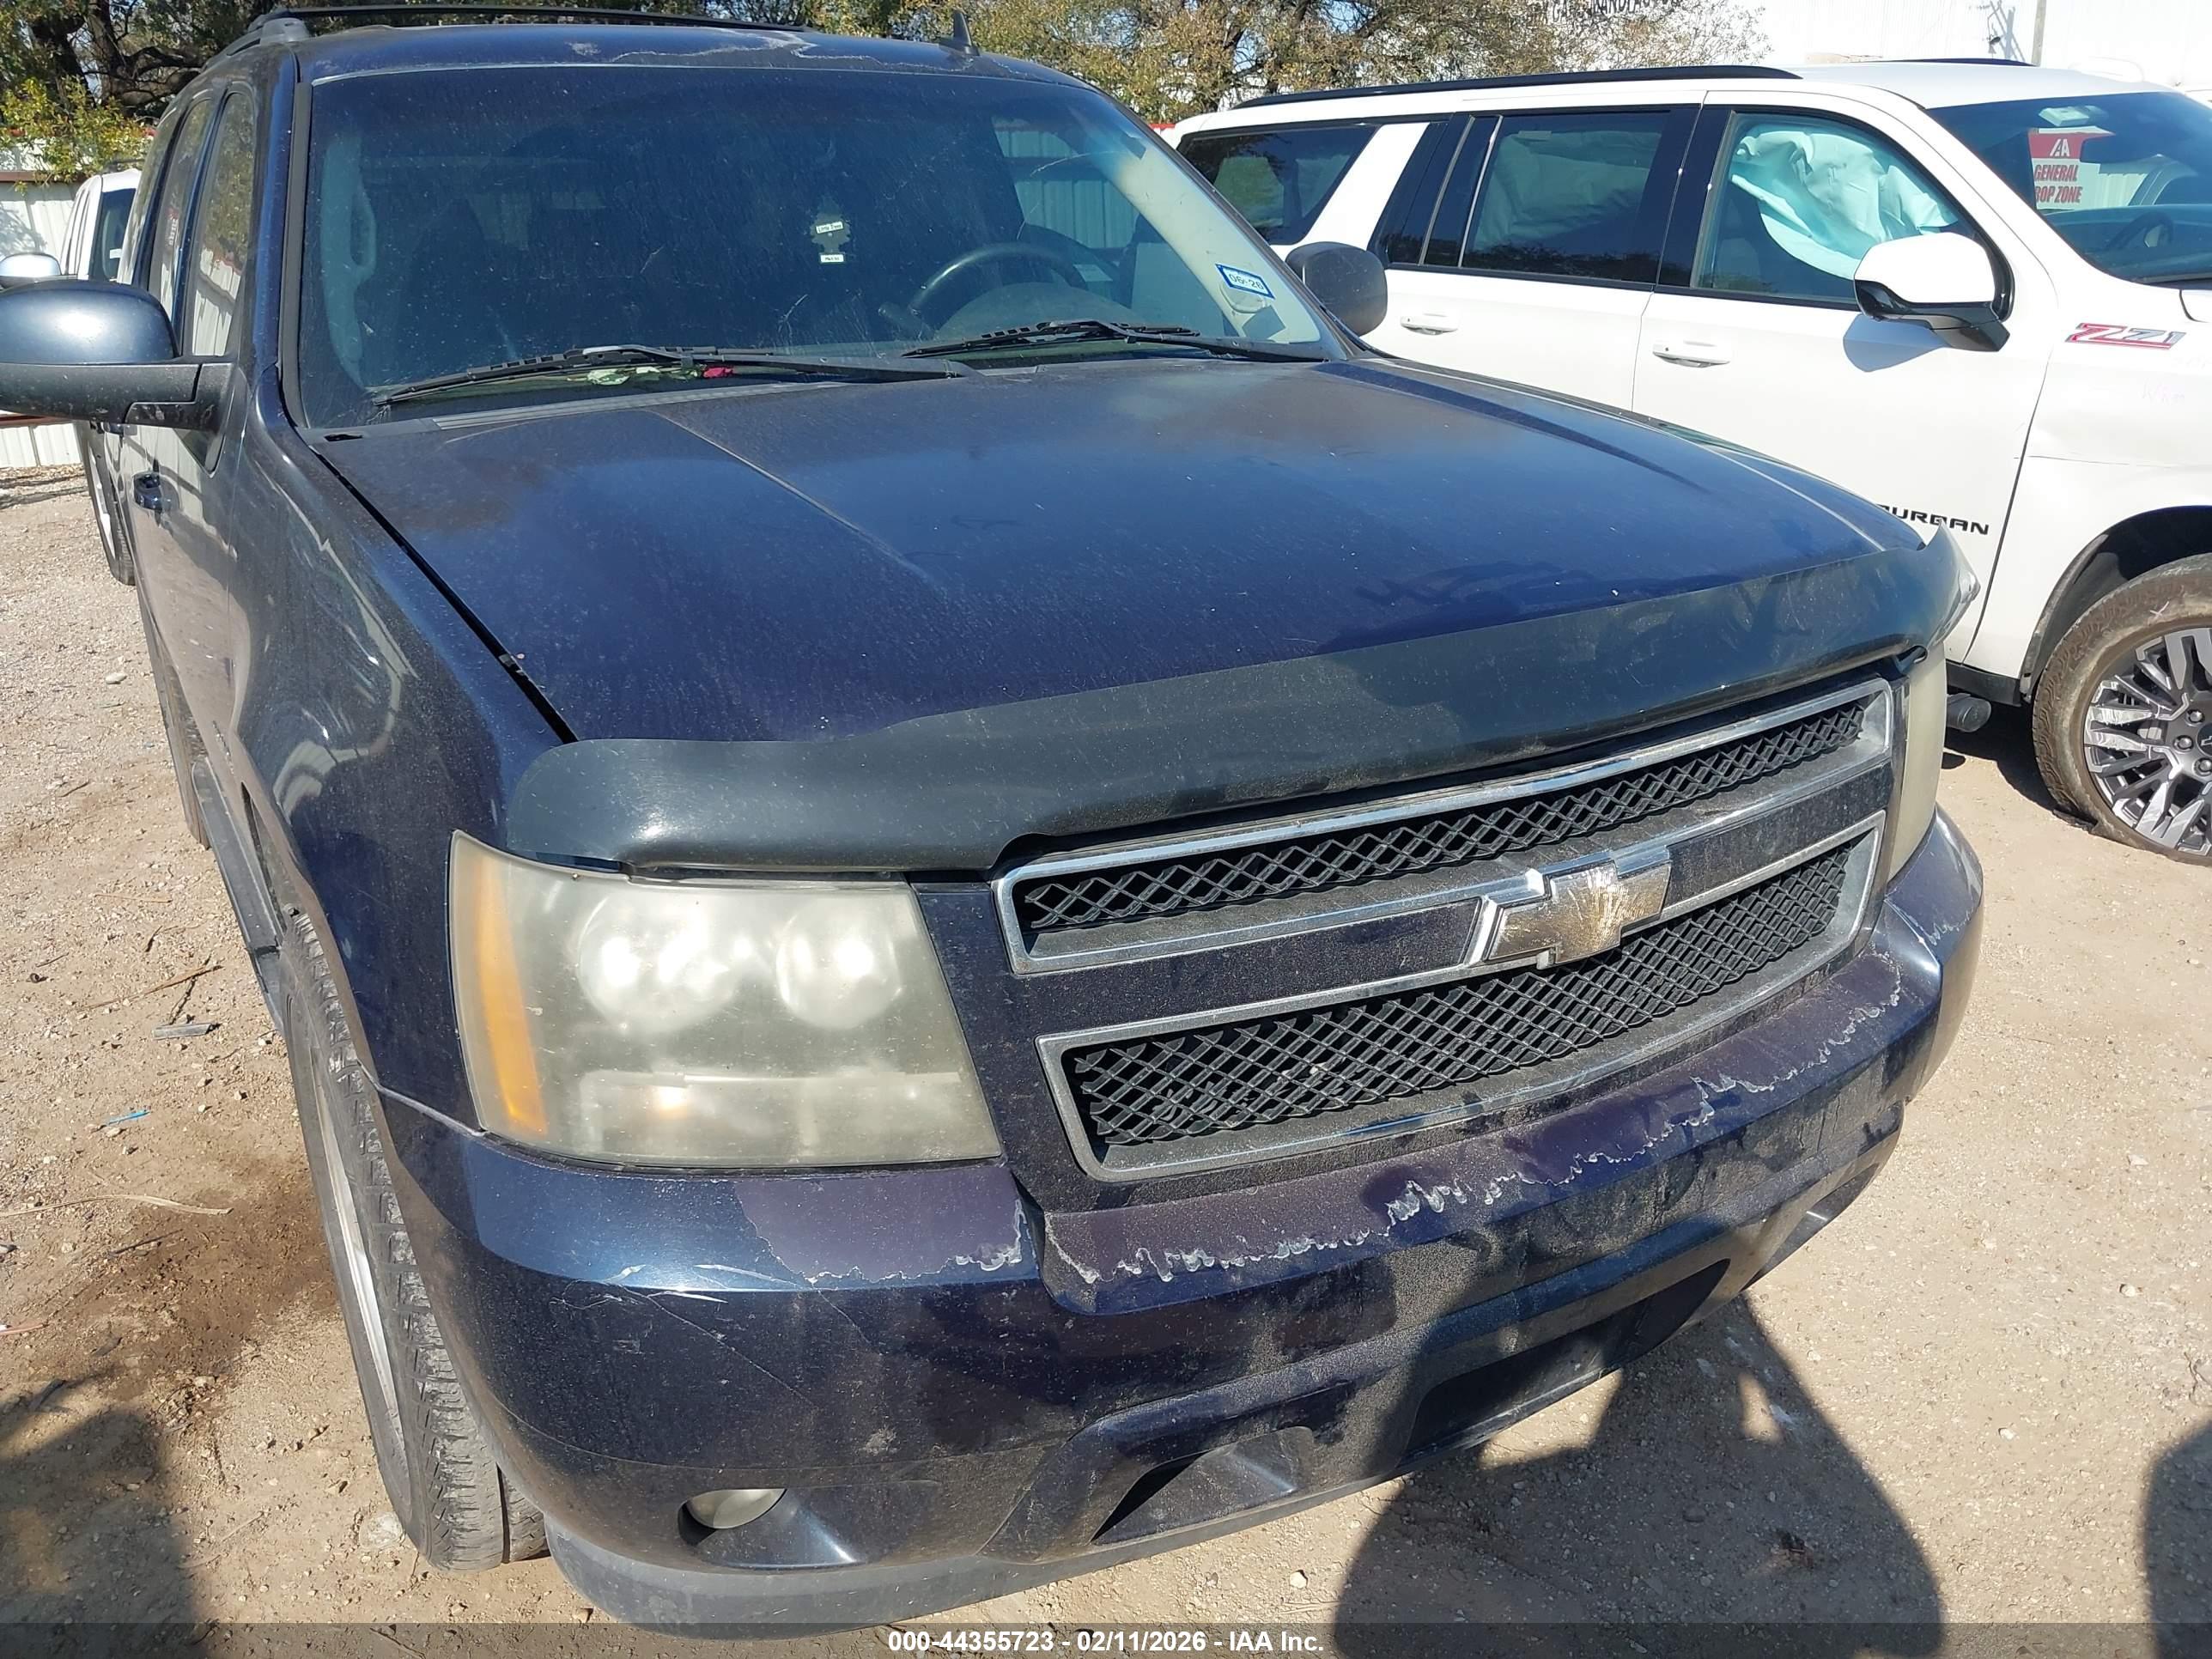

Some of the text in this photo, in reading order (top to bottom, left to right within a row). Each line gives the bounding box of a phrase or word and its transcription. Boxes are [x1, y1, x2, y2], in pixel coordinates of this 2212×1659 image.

[2033, 164, 2079, 182] GENERAL
[2054, 186, 2083, 204] ZONE
[2064, 322, 2188, 350] Z71
[1878, 503, 1989, 535] URBAN
